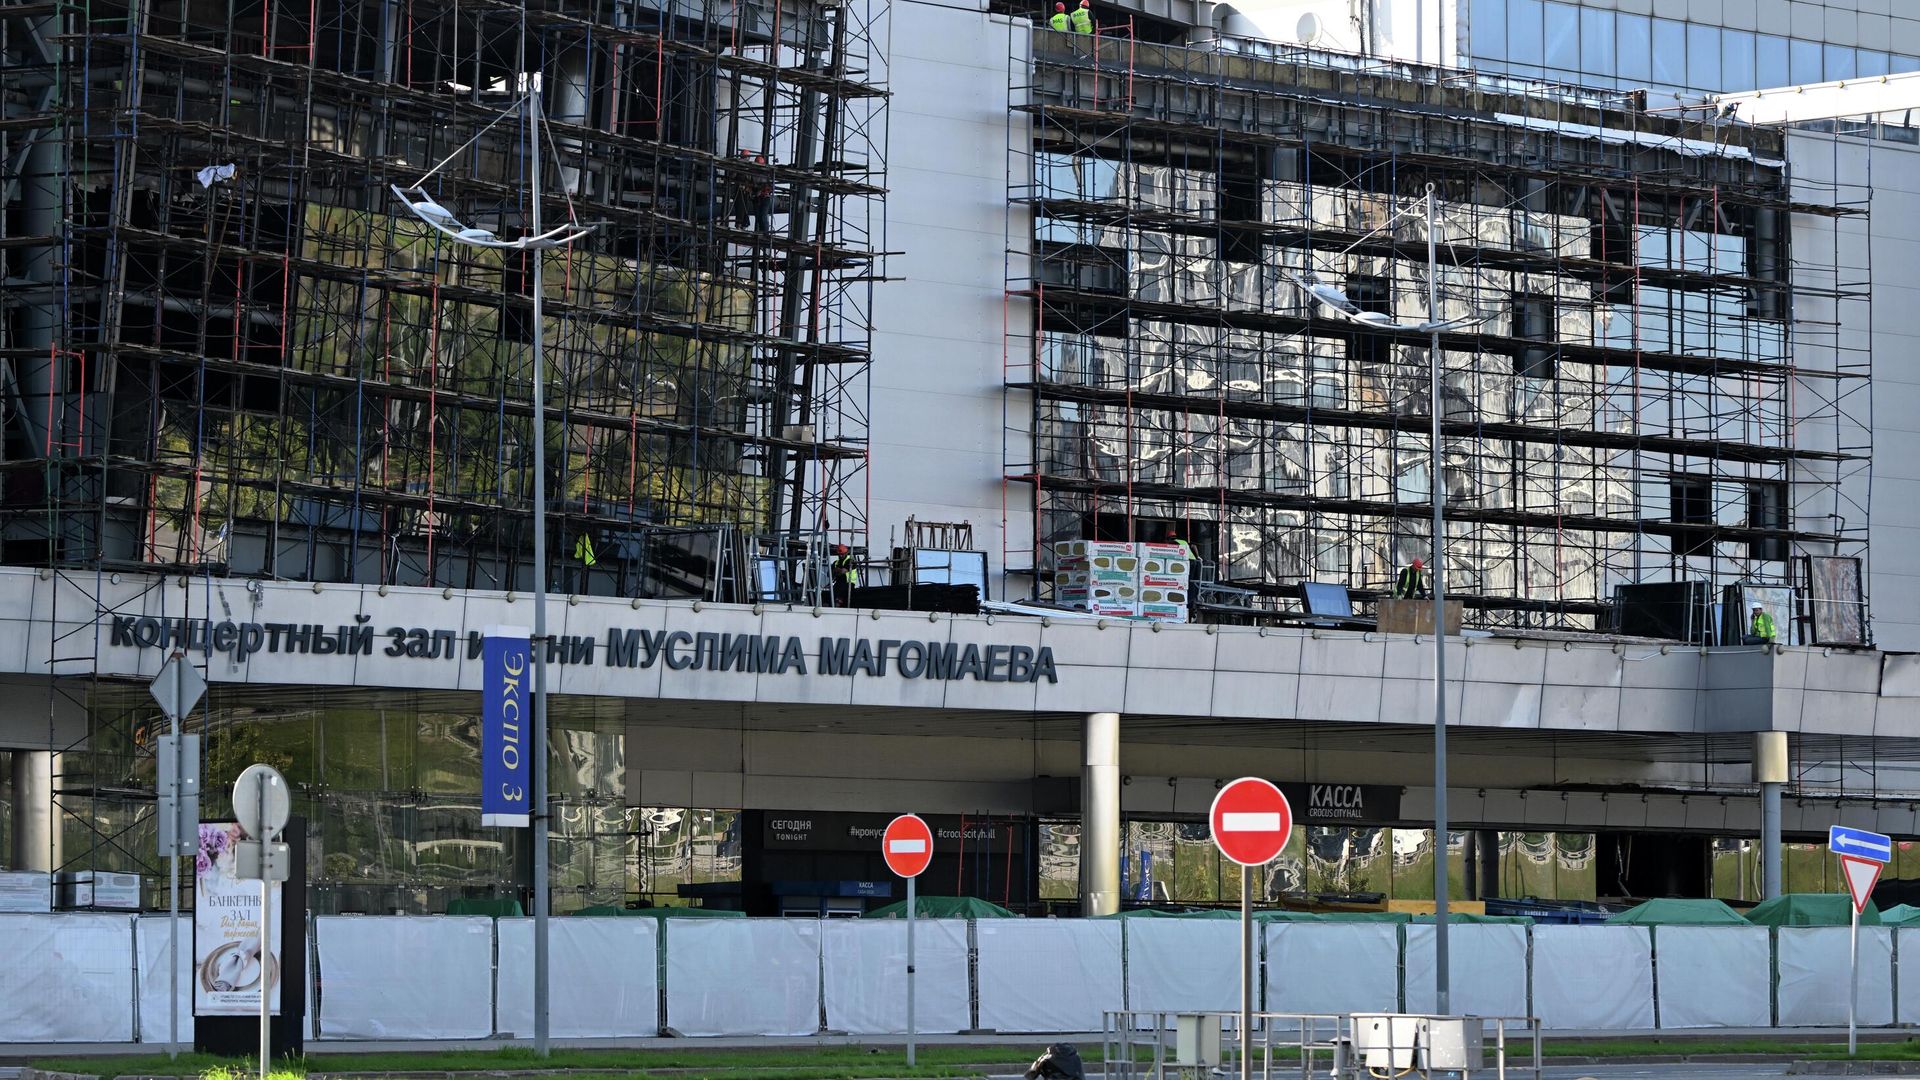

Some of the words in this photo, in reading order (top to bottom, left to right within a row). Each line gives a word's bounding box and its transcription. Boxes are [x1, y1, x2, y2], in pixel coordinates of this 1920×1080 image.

[111, 614, 374, 662] концертный
[385, 627, 457, 660] зал
[468, 631, 595, 665] ини
[606, 627, 807, 675] МУСЛИМА
[818, 636, 1058, 684] МАГОМАЕВА
[502, 650, 524, 770] ЭКСПО
[502, 783, 523, 802] 3
[1310, 784, 1363, 808] КАССА
[1309, 808, 1333, 817] CROCUS
[1334, 809, 1346, 818] CITY
[1347, 809, 1363, 818] HALL
[772, 820, 812, 831] СЕГОДНЯ
[776, 833, 808, 841] TONIGHT
[230, 909, 251, 921] ЗАЛ
